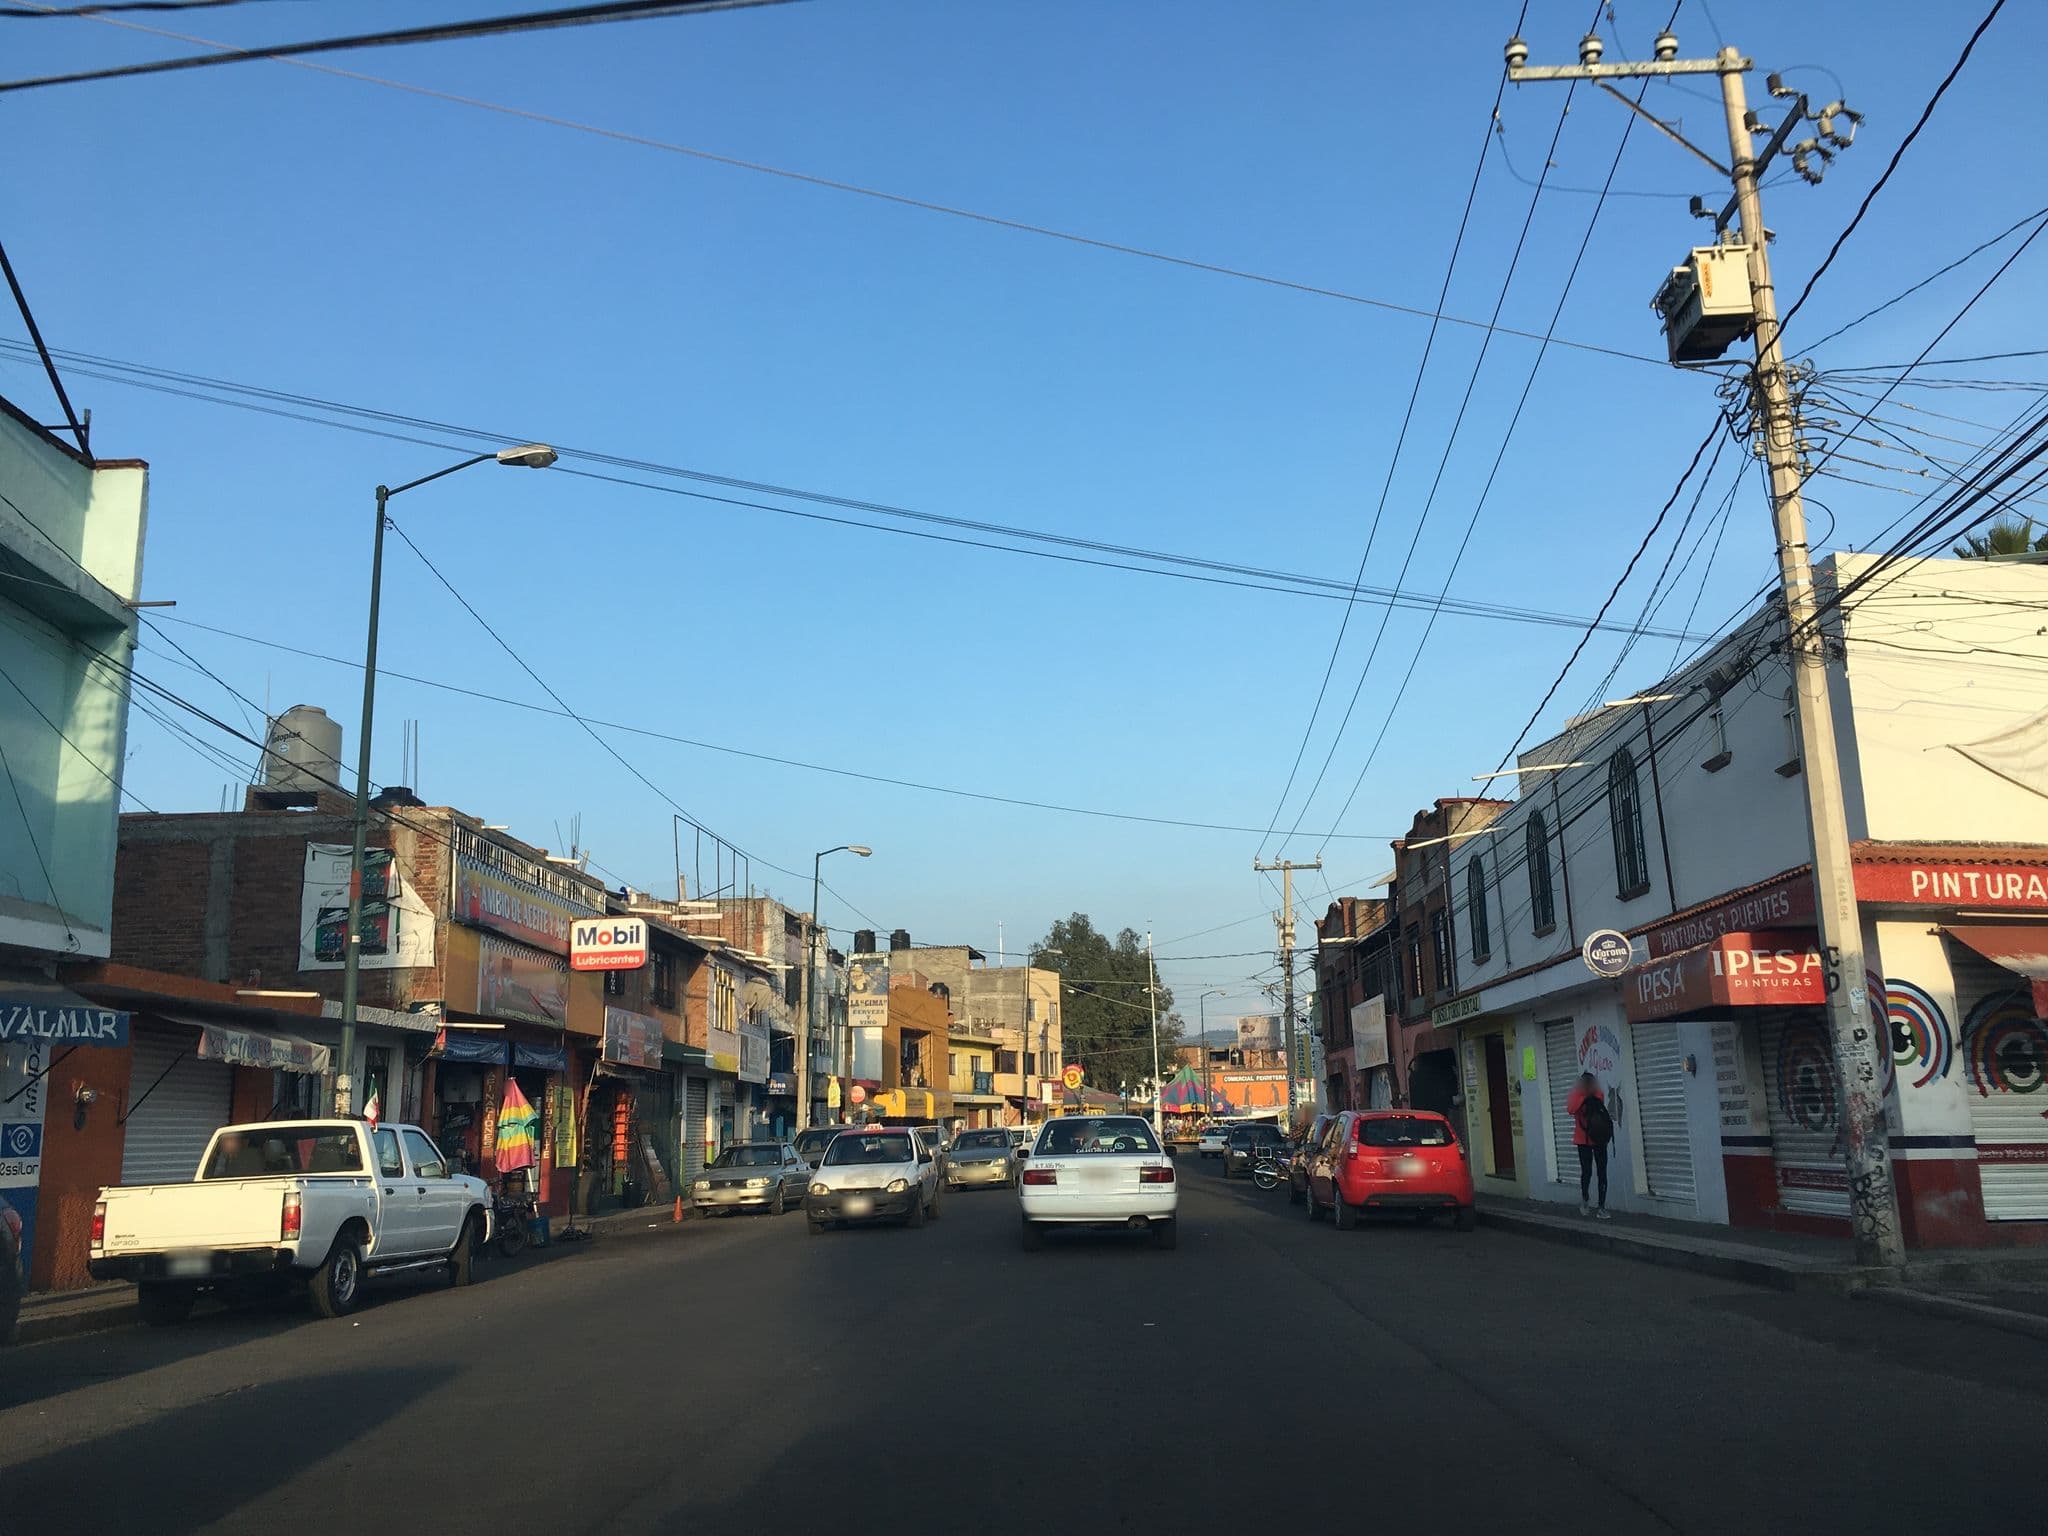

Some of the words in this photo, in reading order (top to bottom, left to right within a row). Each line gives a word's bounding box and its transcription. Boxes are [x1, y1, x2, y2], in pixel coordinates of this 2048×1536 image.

[1911, 870, 2048, 900] PINTURA
[577, 925, 640, 946] Mobil
[1661, 917, 1714, 953] PINTURAS
[1716, 912, 1727, 935] 3
[1730, 890, 1790, 930] PUENTES
[576, 955, 640, 966] Lubricantes
[1591, 948, 1627, 960] Corona
[1711, 944, 1823, 977] IPESA
[1637, 962, 1686, 1004] IPESA
[1734, 977, 1813, 988] PINTURAS
[0, 1006, 118, 1039] VALMAR
[484, 1072, 496, 1149] AFINACIONES
